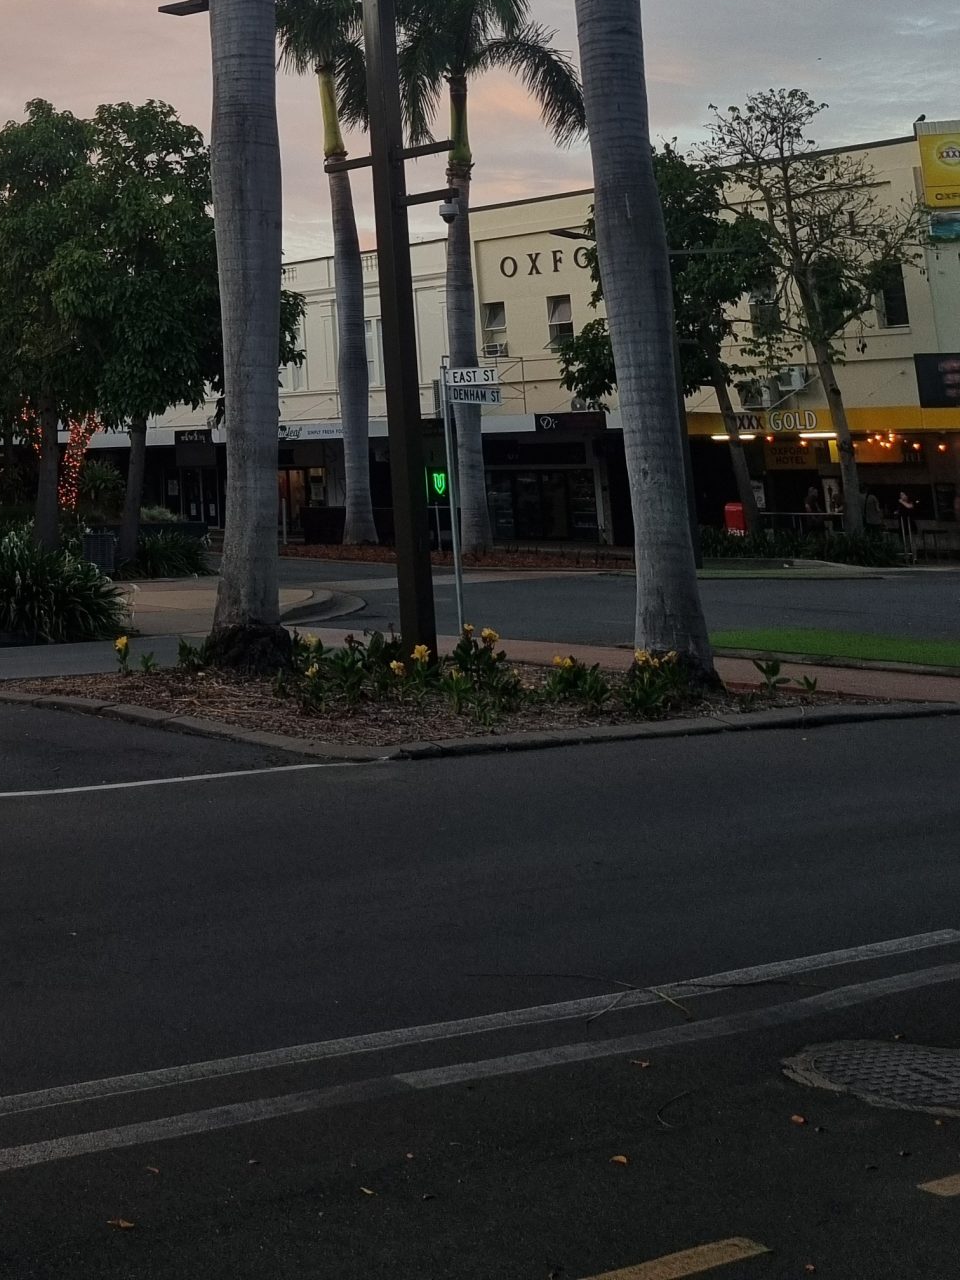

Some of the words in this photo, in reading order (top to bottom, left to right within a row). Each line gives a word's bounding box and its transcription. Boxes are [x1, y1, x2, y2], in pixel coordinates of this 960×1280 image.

[938, 150, 960, 160] XXX
[452, 370, 477, 383] EAST
[483, 369, 495, 381] ST
[453, 388, 487, 402] DENHAM
[490, 390, 500, 402] ST
[769, 409, 817, 431] GOLD
[770, 447, 809, 455] OXFORD
[776, 456, 807, 465] HOTEL
